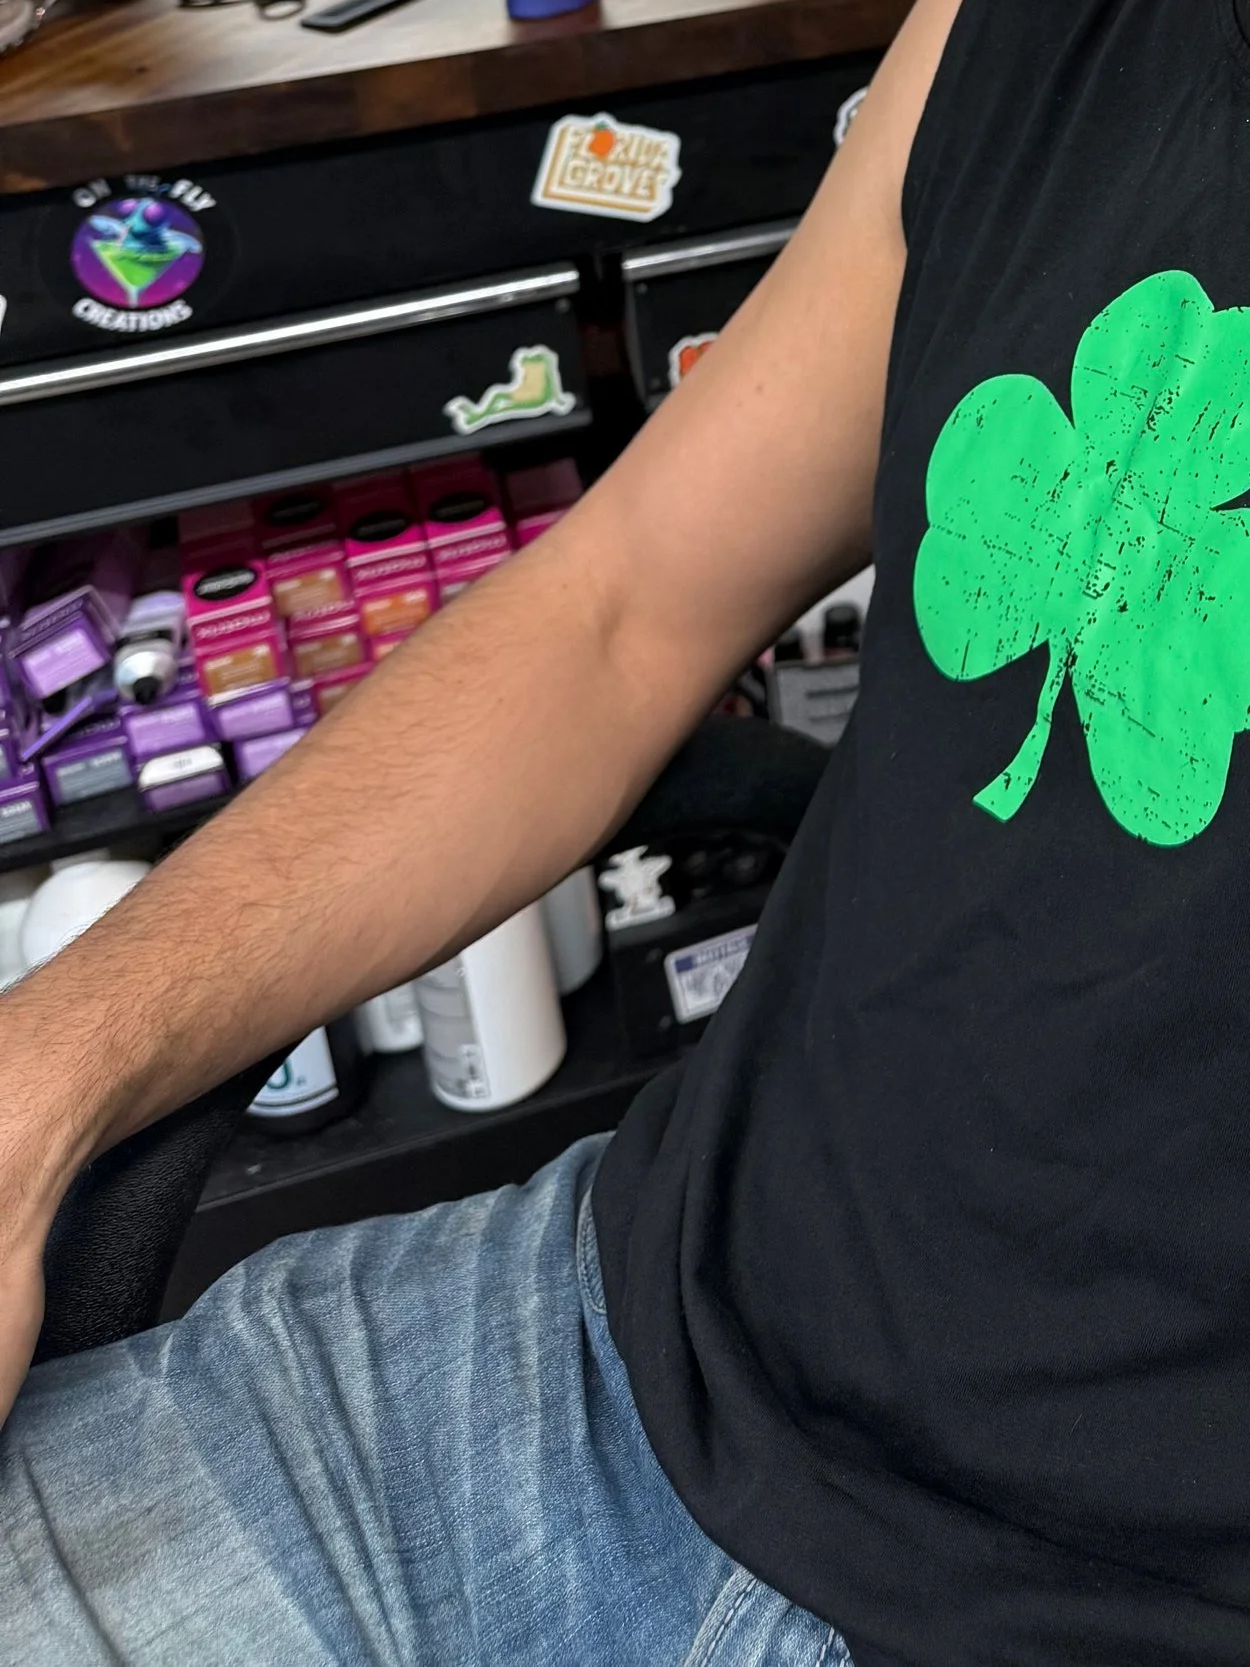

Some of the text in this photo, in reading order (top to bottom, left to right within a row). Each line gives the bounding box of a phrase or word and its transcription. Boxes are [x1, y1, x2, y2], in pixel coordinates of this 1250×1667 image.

[72, 178, 112, 209] ON
[168, 178, 218, 213] FLY
[71, 297, 194, 333] CREATIONS
